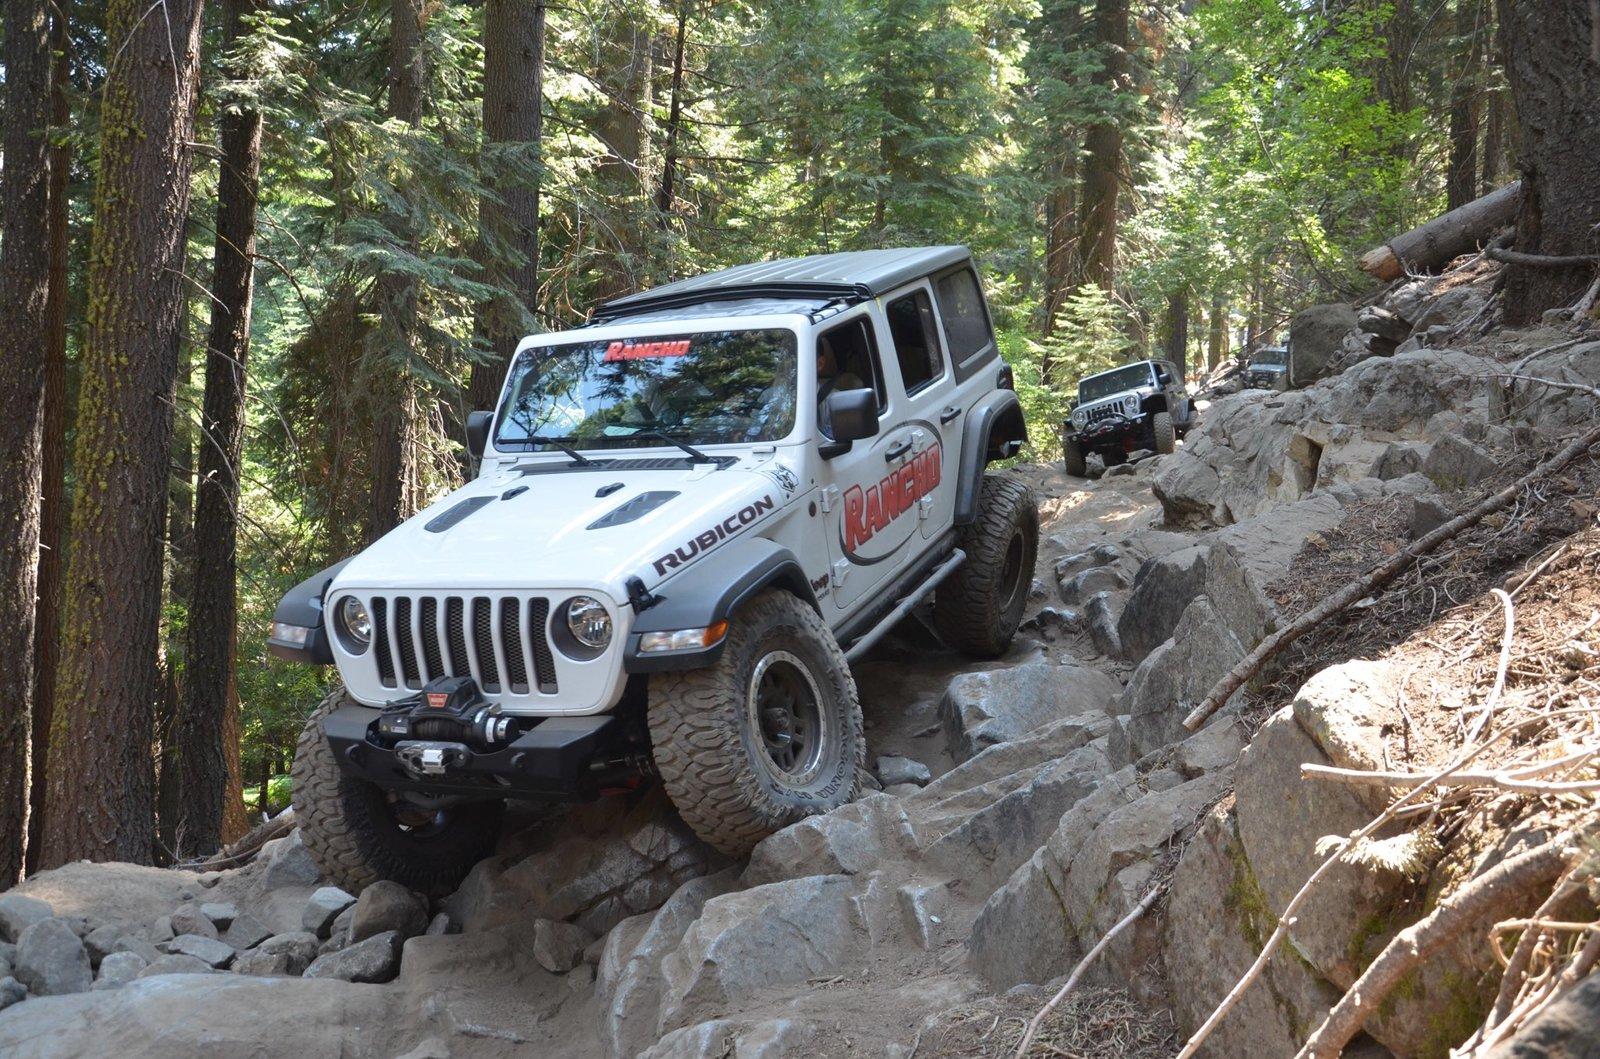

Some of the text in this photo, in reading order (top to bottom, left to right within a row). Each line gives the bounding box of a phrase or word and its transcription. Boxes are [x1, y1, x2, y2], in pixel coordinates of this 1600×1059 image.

[604, 340, 691, 362] RANCHO
[652, 494, 774, 577] RUBICON
[843, 442, 941, 553] RANCHO
